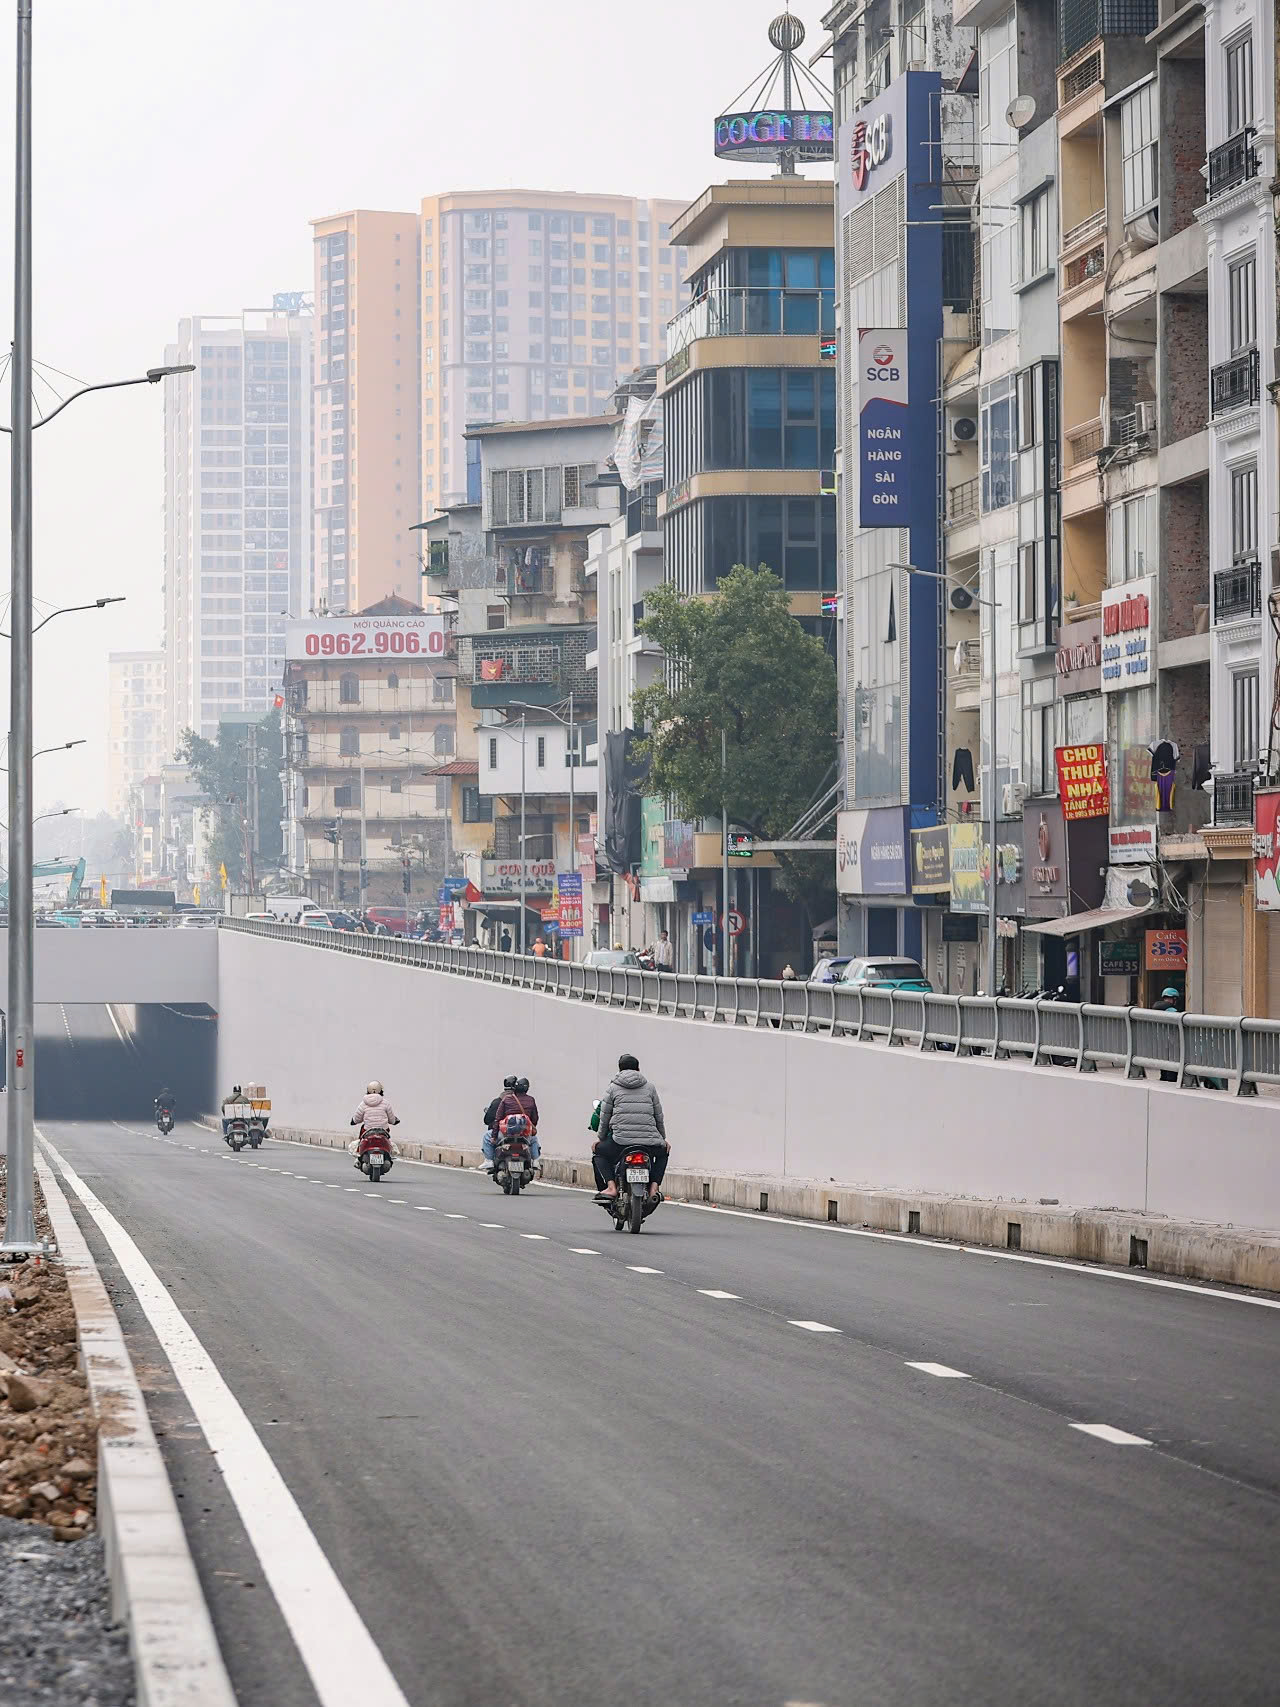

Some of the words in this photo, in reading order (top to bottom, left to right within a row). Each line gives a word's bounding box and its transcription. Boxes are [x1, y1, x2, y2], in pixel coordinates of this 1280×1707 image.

[865, 113, 891, 171] SCB
[867, 367, 900, 381] SCB
[867, 427, 901, 439] NGÂN
[867, 449, 902, 461] HÀNG
[875, 471, 895, 482] SÀI
[872, 493, 898, 504] GÒN
[372, 620, 405, 629] QUẢNG
[406, 620, 425, 628] CÁO
[1063, 746, 1098, 762] CHO
[1061, 761, 1103, 780] THUÊ
[1067, 778, 1103, 798] NHÀ
[847, 840, 857, 865] SCB
[1156, 931, 1177, 939] Café
[1151, 941, 1183, 955] 35
[1125, 961, 1138, 971] 35
